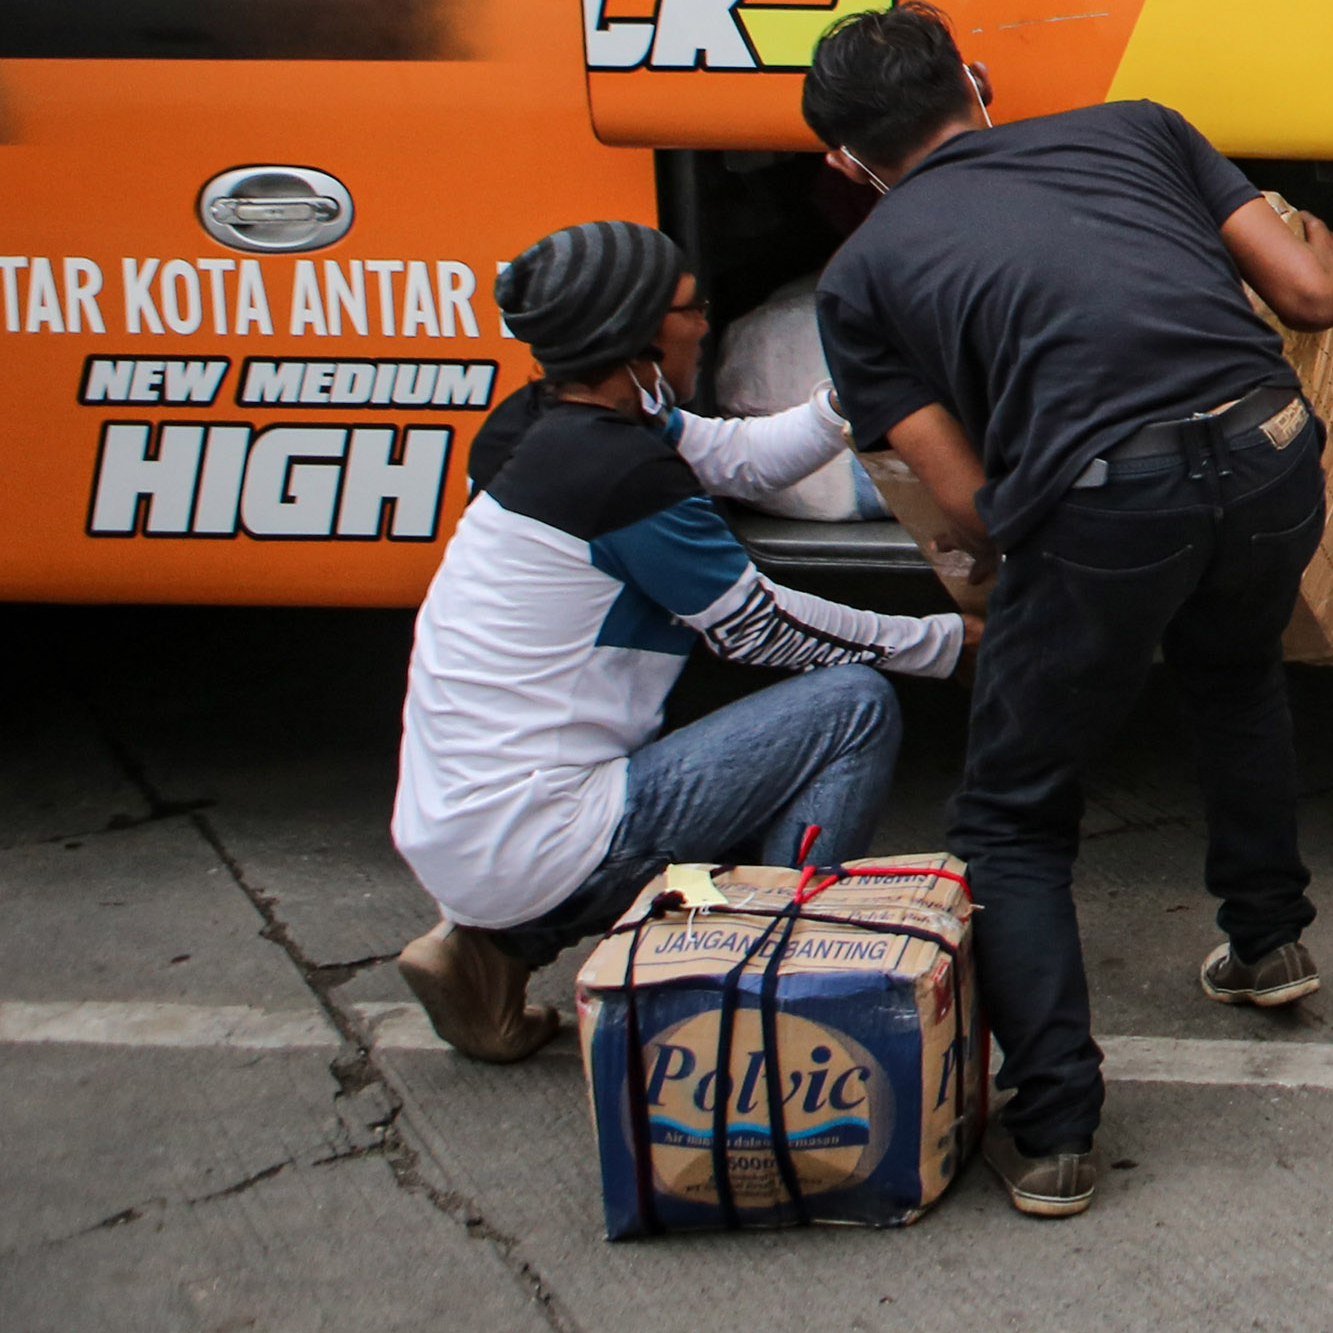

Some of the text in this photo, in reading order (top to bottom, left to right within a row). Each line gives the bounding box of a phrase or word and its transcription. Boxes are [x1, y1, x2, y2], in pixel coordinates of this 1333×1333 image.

[122, 257, 273, 337] KOTA
[290, 259, 479, 338] ANTAR
[80, 355, 498, 410] NEW MEDIUM
[86, 420, 453, 541] HIGH
